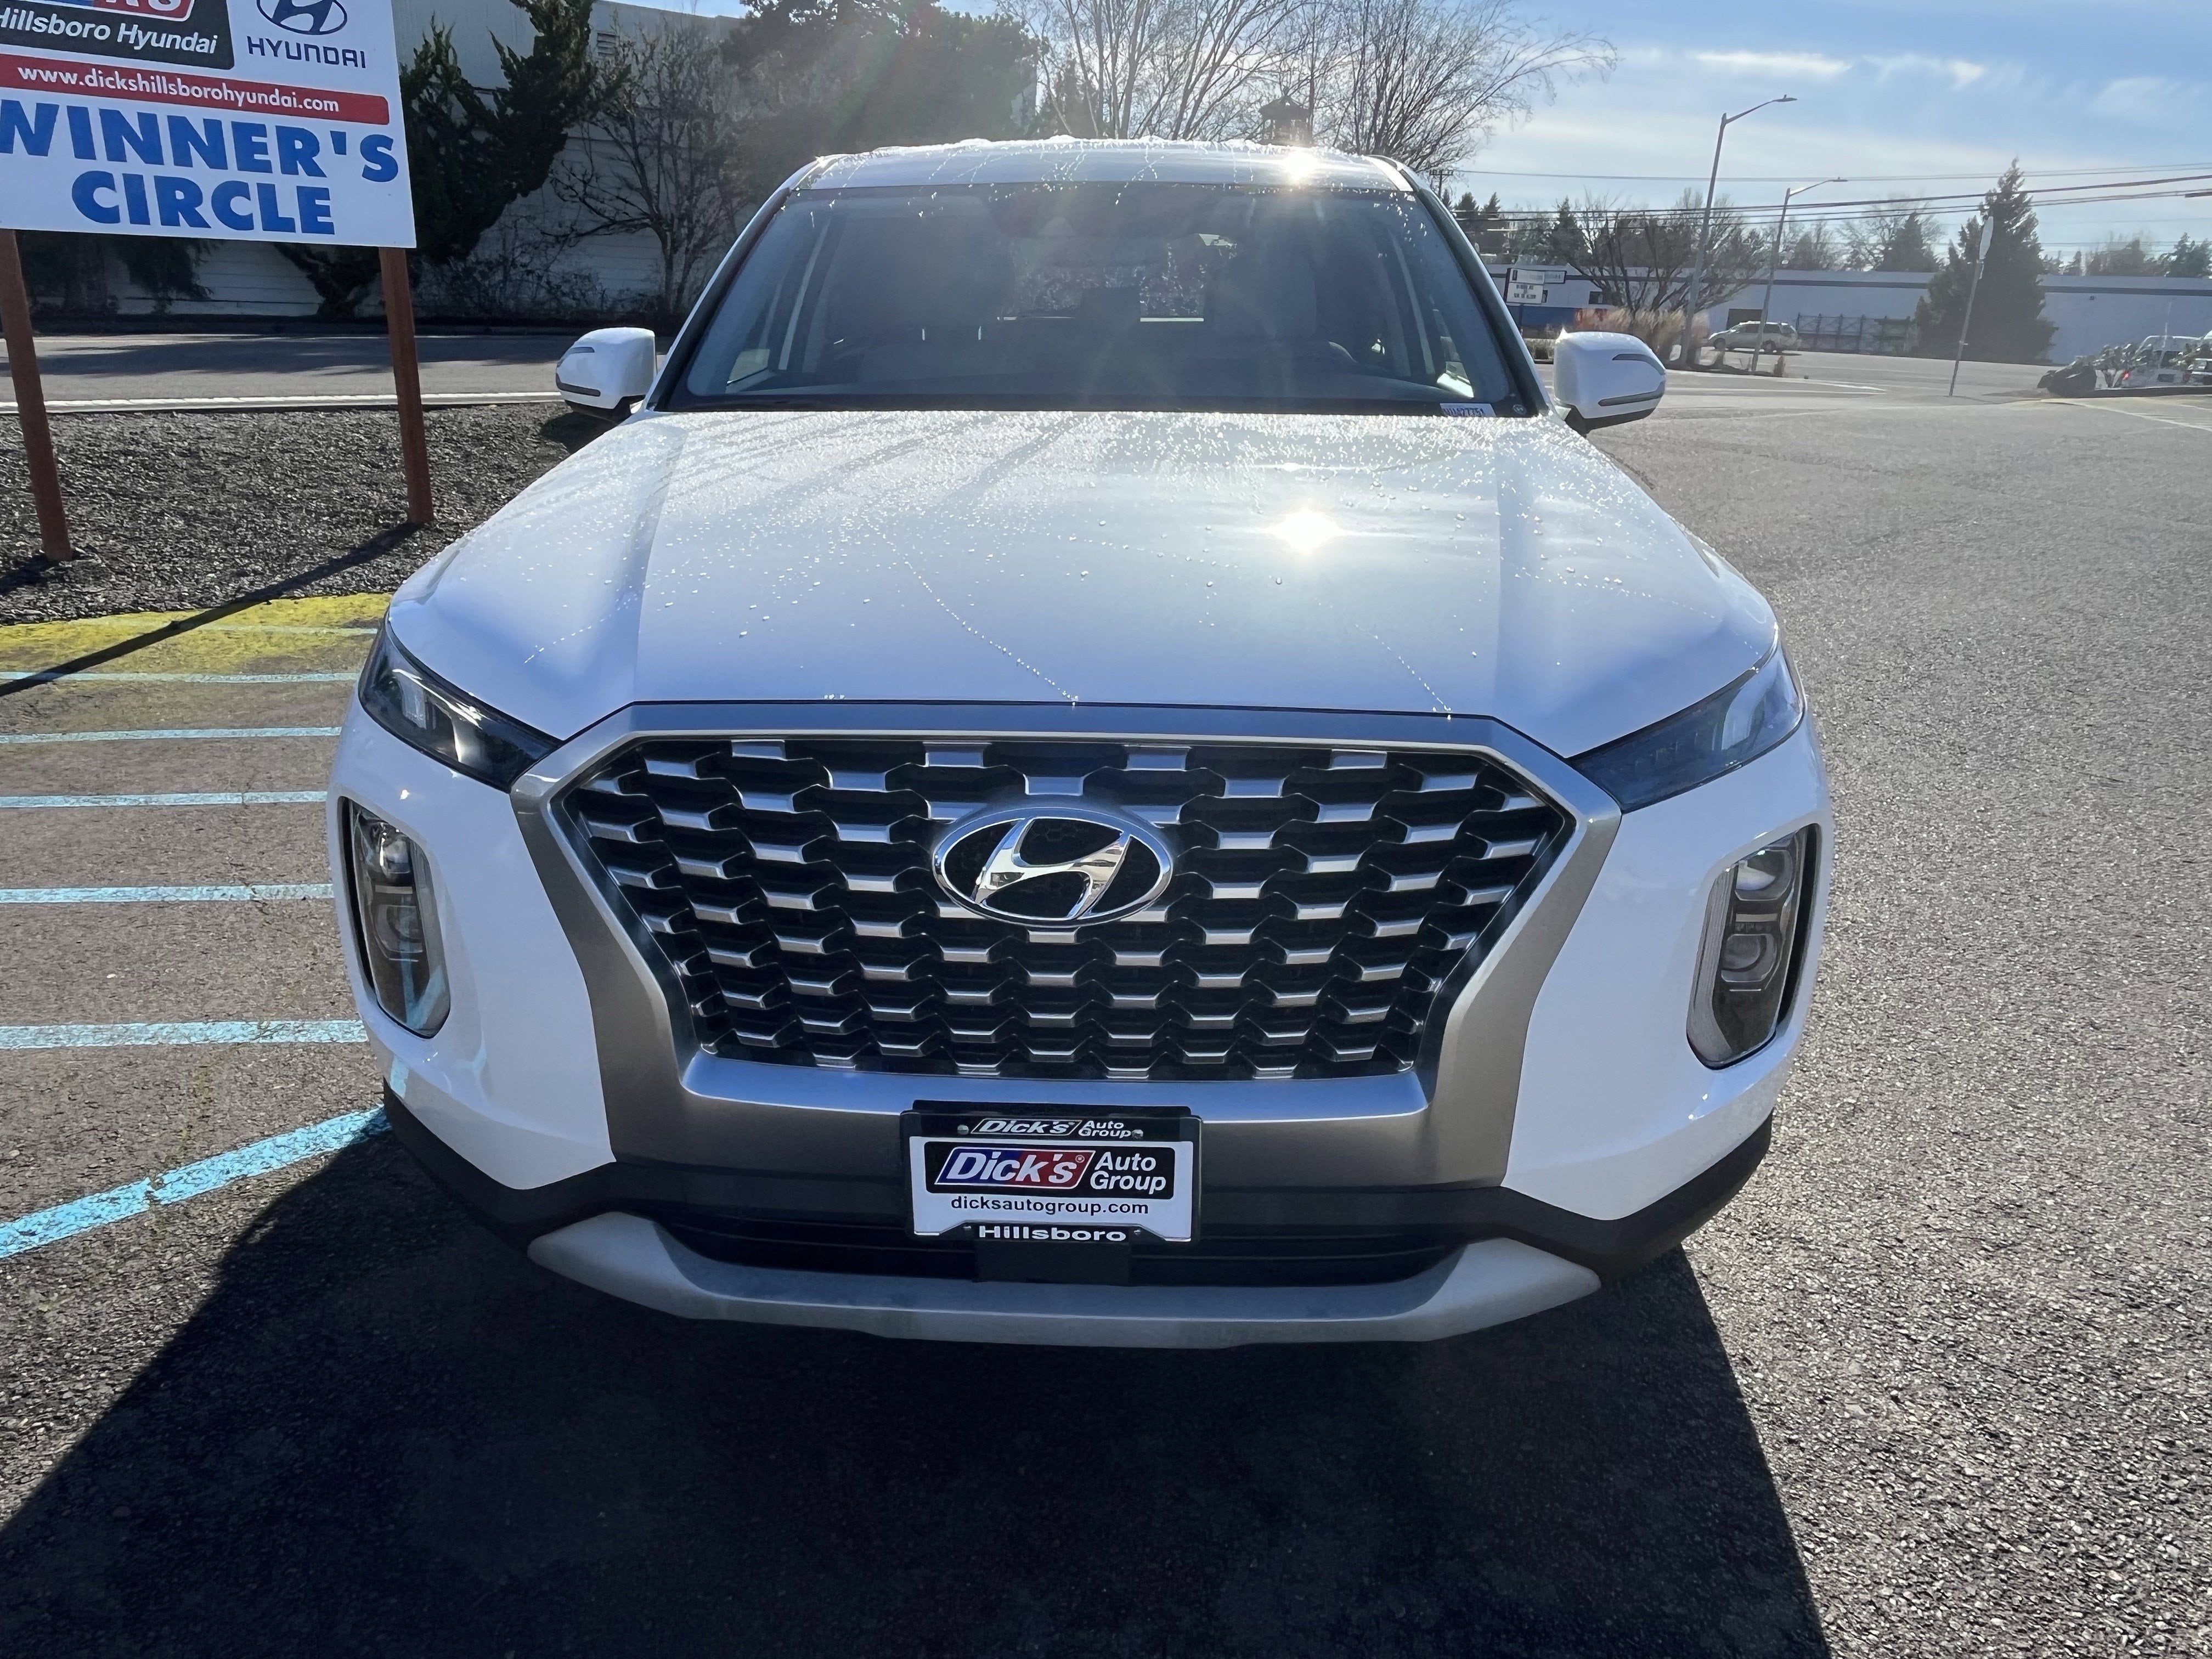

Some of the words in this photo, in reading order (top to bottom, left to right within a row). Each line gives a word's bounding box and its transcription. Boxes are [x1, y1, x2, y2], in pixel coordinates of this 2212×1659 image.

[117, 22, 218, 54] Hyundai
[247, 36, 366, 69] HYUNDAI
[18, 64, 339, 112] www.dickshillsborohyundai.com
[0, 99, 399, 182] WINNER'S
[71, 170, 335, 235] CIRCLE
[1078, 1128, 1132, 1138] Group
[1083, 1120, 1124, 1129] Auto
[946, 1152, 1077, 1184] Dick's
[1094, 1152, 1156, 1171] Auto
[1090, 1170, 1166, 1195] Group
[951, 1196, 1149, 1215] dicksautogroup.com
[979, 1226, 1126, 1242] Hillsboro
